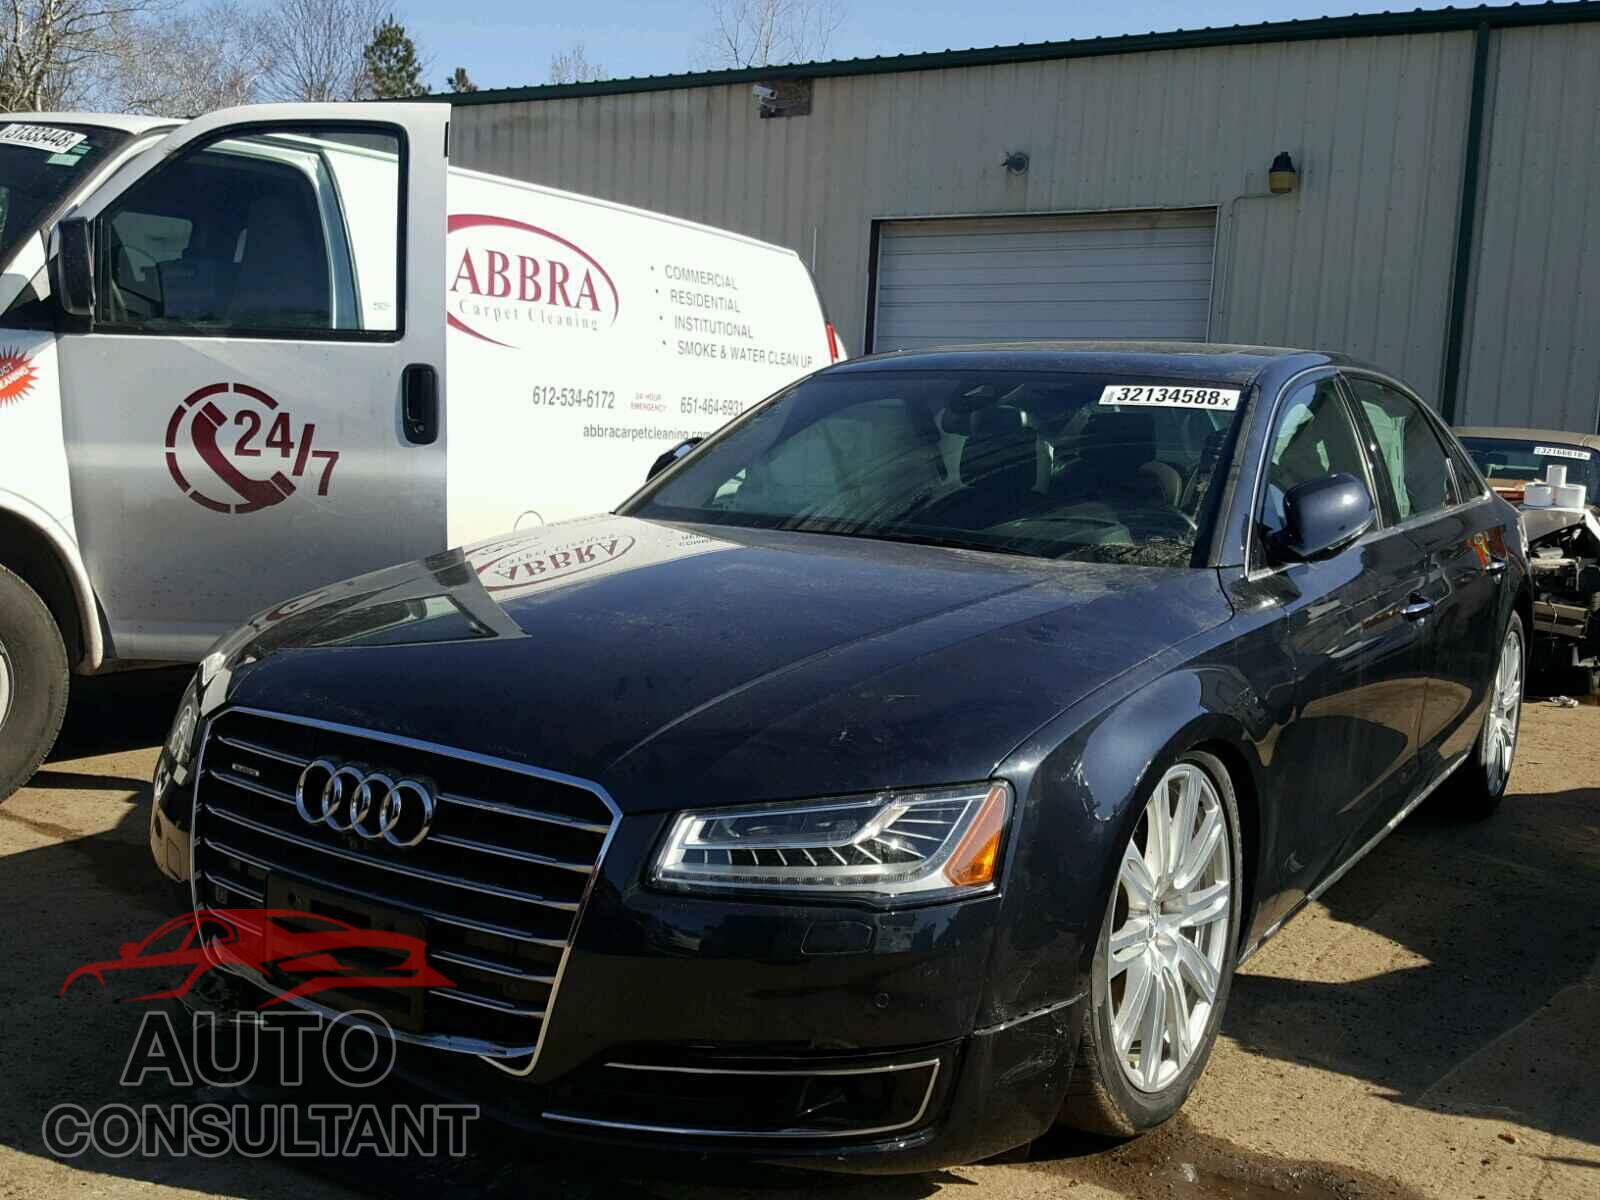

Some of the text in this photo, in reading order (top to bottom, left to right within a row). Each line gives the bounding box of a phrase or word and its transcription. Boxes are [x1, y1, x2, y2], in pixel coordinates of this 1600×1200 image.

[450, 248, 600, 311] ABBRA
[665, 264, 738, 290] COMMERCIAL
[670, 289, 740, 313] RESIDENTIAL
[459, 300, 599, 331] Carpet Cleaning
[674, 315, 753, 339] INSTITUTIONAL
[677, 340, 813, 369] SMOKE & WATER CLEAN UP
[532, 386, 615, 409] 612-534-6172
[630, 401, 667, 413] EMERGENCY
[680, 396, 743, 416] 651-464-6931
[583, 424, 711, 442] abbracarpetcleaning.com
[233, 409, 340, 497] 24/7
